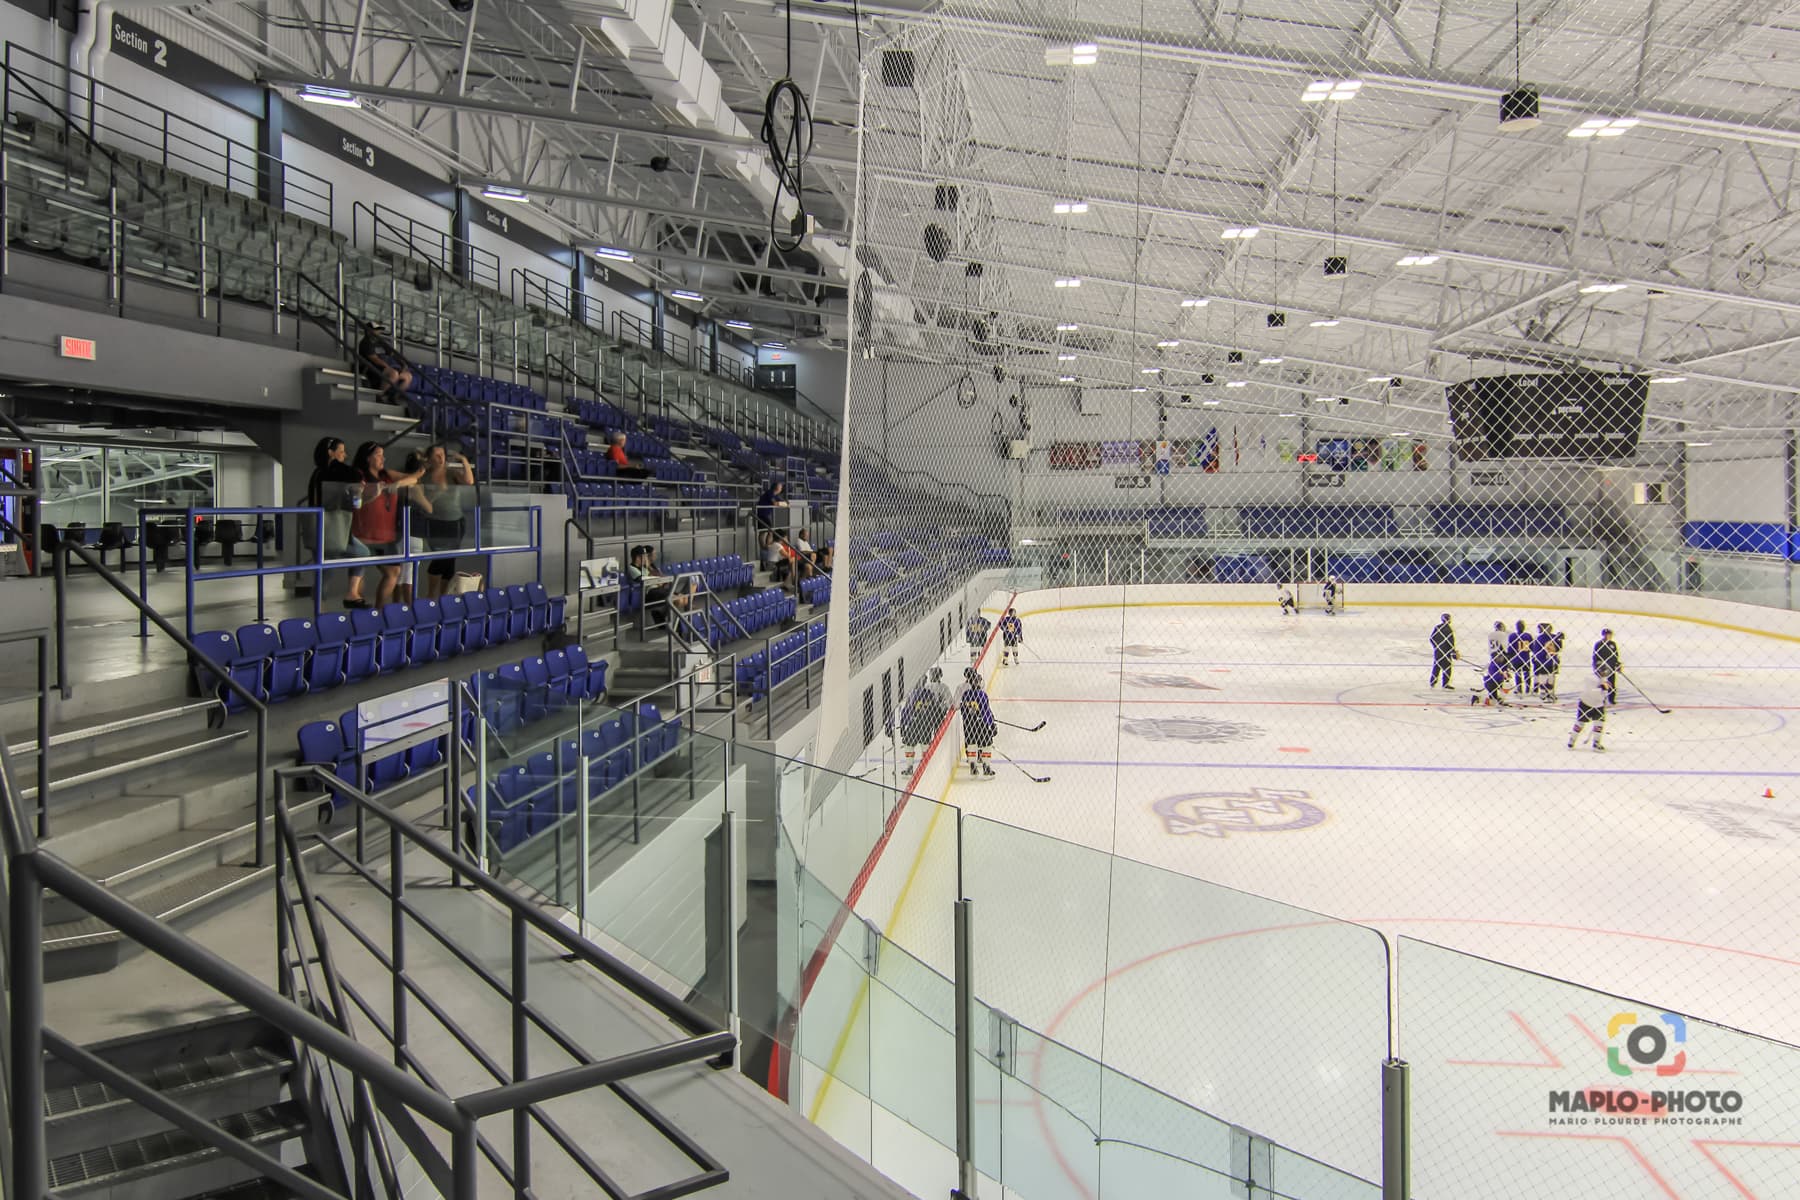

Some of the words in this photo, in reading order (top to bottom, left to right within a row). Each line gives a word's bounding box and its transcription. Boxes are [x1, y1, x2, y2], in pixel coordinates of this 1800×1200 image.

[115, 23, 148, 54] Section
[154, 40, 167, 67] 2
[342, 137, 363, 159] Section
[366, 146, 375, 167] 3
[502, 216, 508, 233] 4
